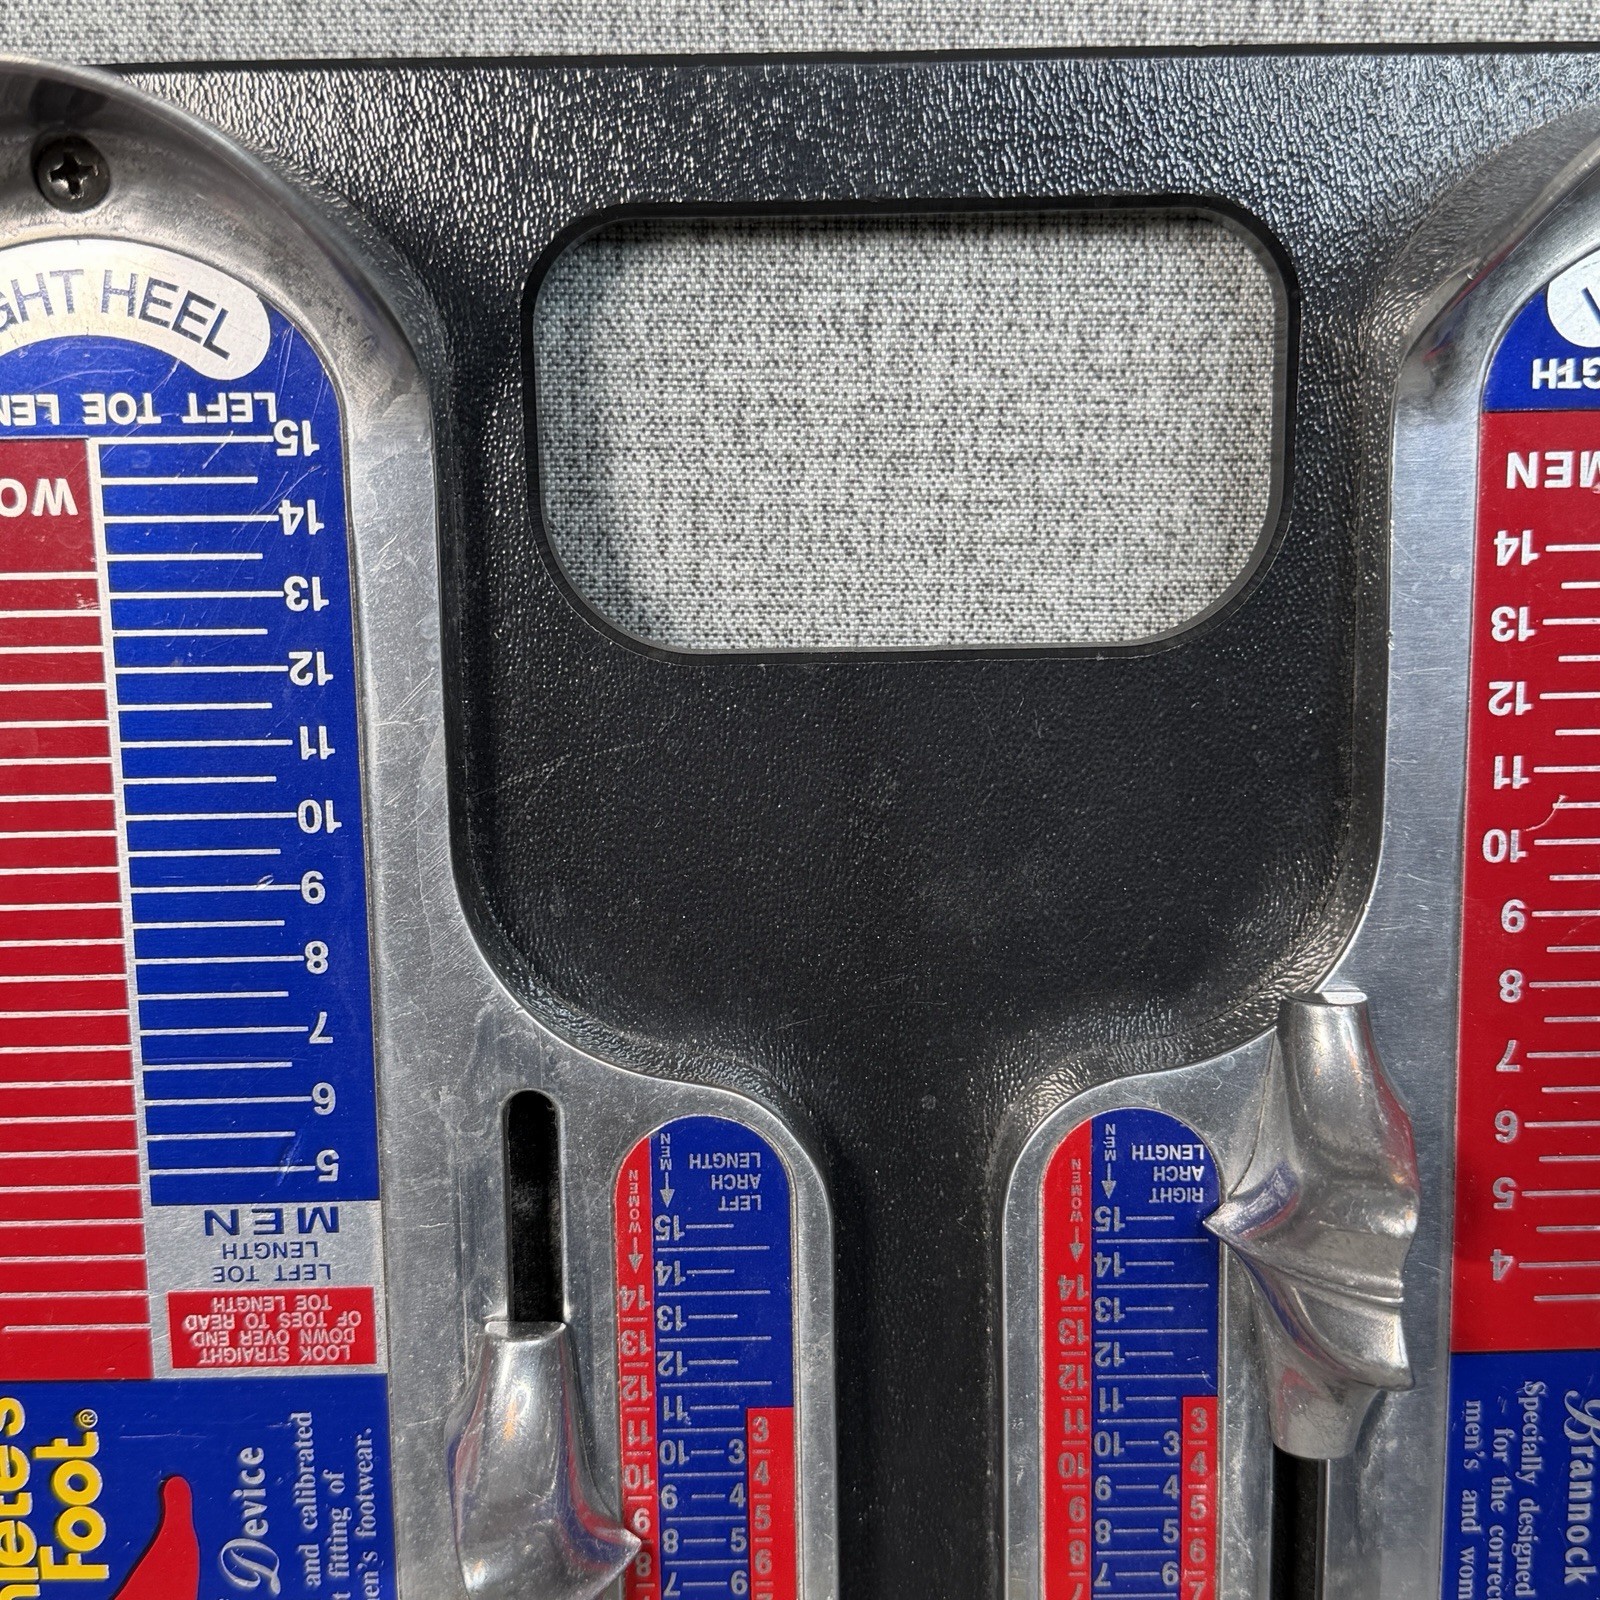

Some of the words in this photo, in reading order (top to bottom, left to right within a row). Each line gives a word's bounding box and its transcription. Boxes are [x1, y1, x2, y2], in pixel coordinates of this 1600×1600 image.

[101, 269, 231, 361] HEEL
[82, 392, 162, 425] TOE
[181, 392, 277, 424] LEFT
[274, 420, 320, 457] 15
[278, 499, 324, 535] 14
[1494, 530, 1540, 567] 14
[283, 576, 329, 612] 13
[1491, 606, 1537, 642] 13
[288, 651, 333, 686] 12
[1488, 681, 1534, 716] 12
[299, 726, 335, 760] 11
[1494, 755, 1532, 790] 11
[297, 799, 342, 834] 10
[1482, 828, 1528, 863] 10
[301, 870, 326, 905] 9
[1501, 899, 1526, 933] 9
[304, 940, 328, 975] 8
[1499, 969, 1523, 1003] 8
[309, 1012, 333, 1044] 7
[1495, 1039, 1521, 1072] 7
[311, 1082, 336, 1115] 6
[1494, 1110, 1518, 1143] 6
[660, 1133, 672, 1170] MEN
[1103, 1123, 1116, 1161] MEN
[1132, 1144, 1204, 1161] LENGTH
[316, 1149, 340, 1182] 5
[689, 1152, 761, 1169] LENGTH
[711, 1174, 761, 1190] ARCH
[1154, 1166, 1205, 1182] ARCH
[628, 1170, 641, 1233] WOMEN
[718, 1195, 762, 1211] LEFT
[1070, 1159, 1083, 1222] WOMEN
[1149, 1187, 1203, 1203] RIGHT
[1492, 1176, 1517, 1210] 5
[204, 1206, 340, 1236] MEN
[654, 1215, 685, 1241] 15
[1094, 1206, 1125, 1232] 15
[222, 1241, 319, 1260] LENGTH
[213, 1266, 260, 1283] TOE
[274, 1264, 332, 1281] LEFT
[654, 1260, 686, 1286] 14
[1094, 1252, 1125, 1277] 14
[1490, 1249, 1514, 1281] 4
[620, 1285, 650, 1310] 14
[1058, 1275, 1089, 1300] 14
[211, 1295, 286, 1312] LENGTH
[295, 1295, 332, 1310] TOE
[1094, 1297, 1125, 1322] 13
[183, 1315, 235, 1331] READ
[246, 1313, 270, 1328] TO
[279, 1312, 328, 1328] TOES
[338, 1311, 362, 1327] OF
[656, 1306, 687, 1331] 13
[1058, 1318, 1089, 1345] 13
[192, 1331, 230, 1347] END
[240, 1329, 290, 1346] OVER
[300, 1328, 355, 1344] DOWN
[620, 1330, 651, 1356] 13
[199, 1346, 289, 1365] STRAIGHT
[300, 1346, 350, 1362] LOOK
[657, 1351, 688, 1376] 12
[1094, 1342, 1125, 1367] 12
[622, 1375, 652, 1401] 12
[1058, 1364, 1088, 1390] 12
[663, 1396, 689, 1422] 11
[1099, 1387, 1124, 1413] 11
[627, 1420, 652, 1446] 11
[752, 1416, 769, 1442] 3
[1064, 1409, 1088, 1434] 11
[1190, 1407, 1207, 1433] 3
[1515, 1380, 1548, 1486] Specially
[1094, 1431, 1124, 1457] 10
[1162, 1431, 1180, 1456] 3
[1463, 1400, 1486, 1470] men's
[1492, 1427, 1515, 1464] for
[659, 1439, 689, 1465] 10
[728, 1439, 745, 1464] 3
[1190, 1451, 1207, 1476] 4
[291, 1412, 318, 1530] calibrated
[624, 1464, 654, 1489] 10
[753, 1461, 769, 1485] 4
[1058, 1452, 1088, 1479] 10
[323, 1469, 345, 1494] of
[356, 1428, 377, 1537] footwear.
[1095, 1475, 1112, 1500] 9
[1162, 1474, 1180, 1499] 4
[1490, 1475, 1513, 1513] the
[1563, 1390, 1600, 1585] Brannock
[661, 1485, 678, 1509] 9
[729, 1483, 746, 1508] 4
[1190, 1495, 1206, 1520] 5
[221, 1447, 281, 1595] Device
[755, 1505, 770, 1530] 5
[1461, 1489, 1481, 1533] and
[328, 1507, 352, 1577] fitting
[663, 1529, 679, 1553] 8
[730, 1528, 746, 1552] 5
[1095, 1519, 1112, 1544] 8
[1162, 1519, 1180, 1544] 5
[1069, 1540, 1086, 1566] 8
[1189, 1539, 1206, 1563] 6
[1511, 1498, 1540, 1598] designed
[298, 1544, 321, 1587] and
[635, 1552, 651, 1577] 8
[755, 1550, 772, 1574] 6
[1094, 1562, 1111, 1587] 7
[1162, 1561, 1179, 1586] 6
[1458, 1546, 1475, 1600] wom
[664, 1572, 680, 1596] 7
[730, 1570, 748, 1594] 6
